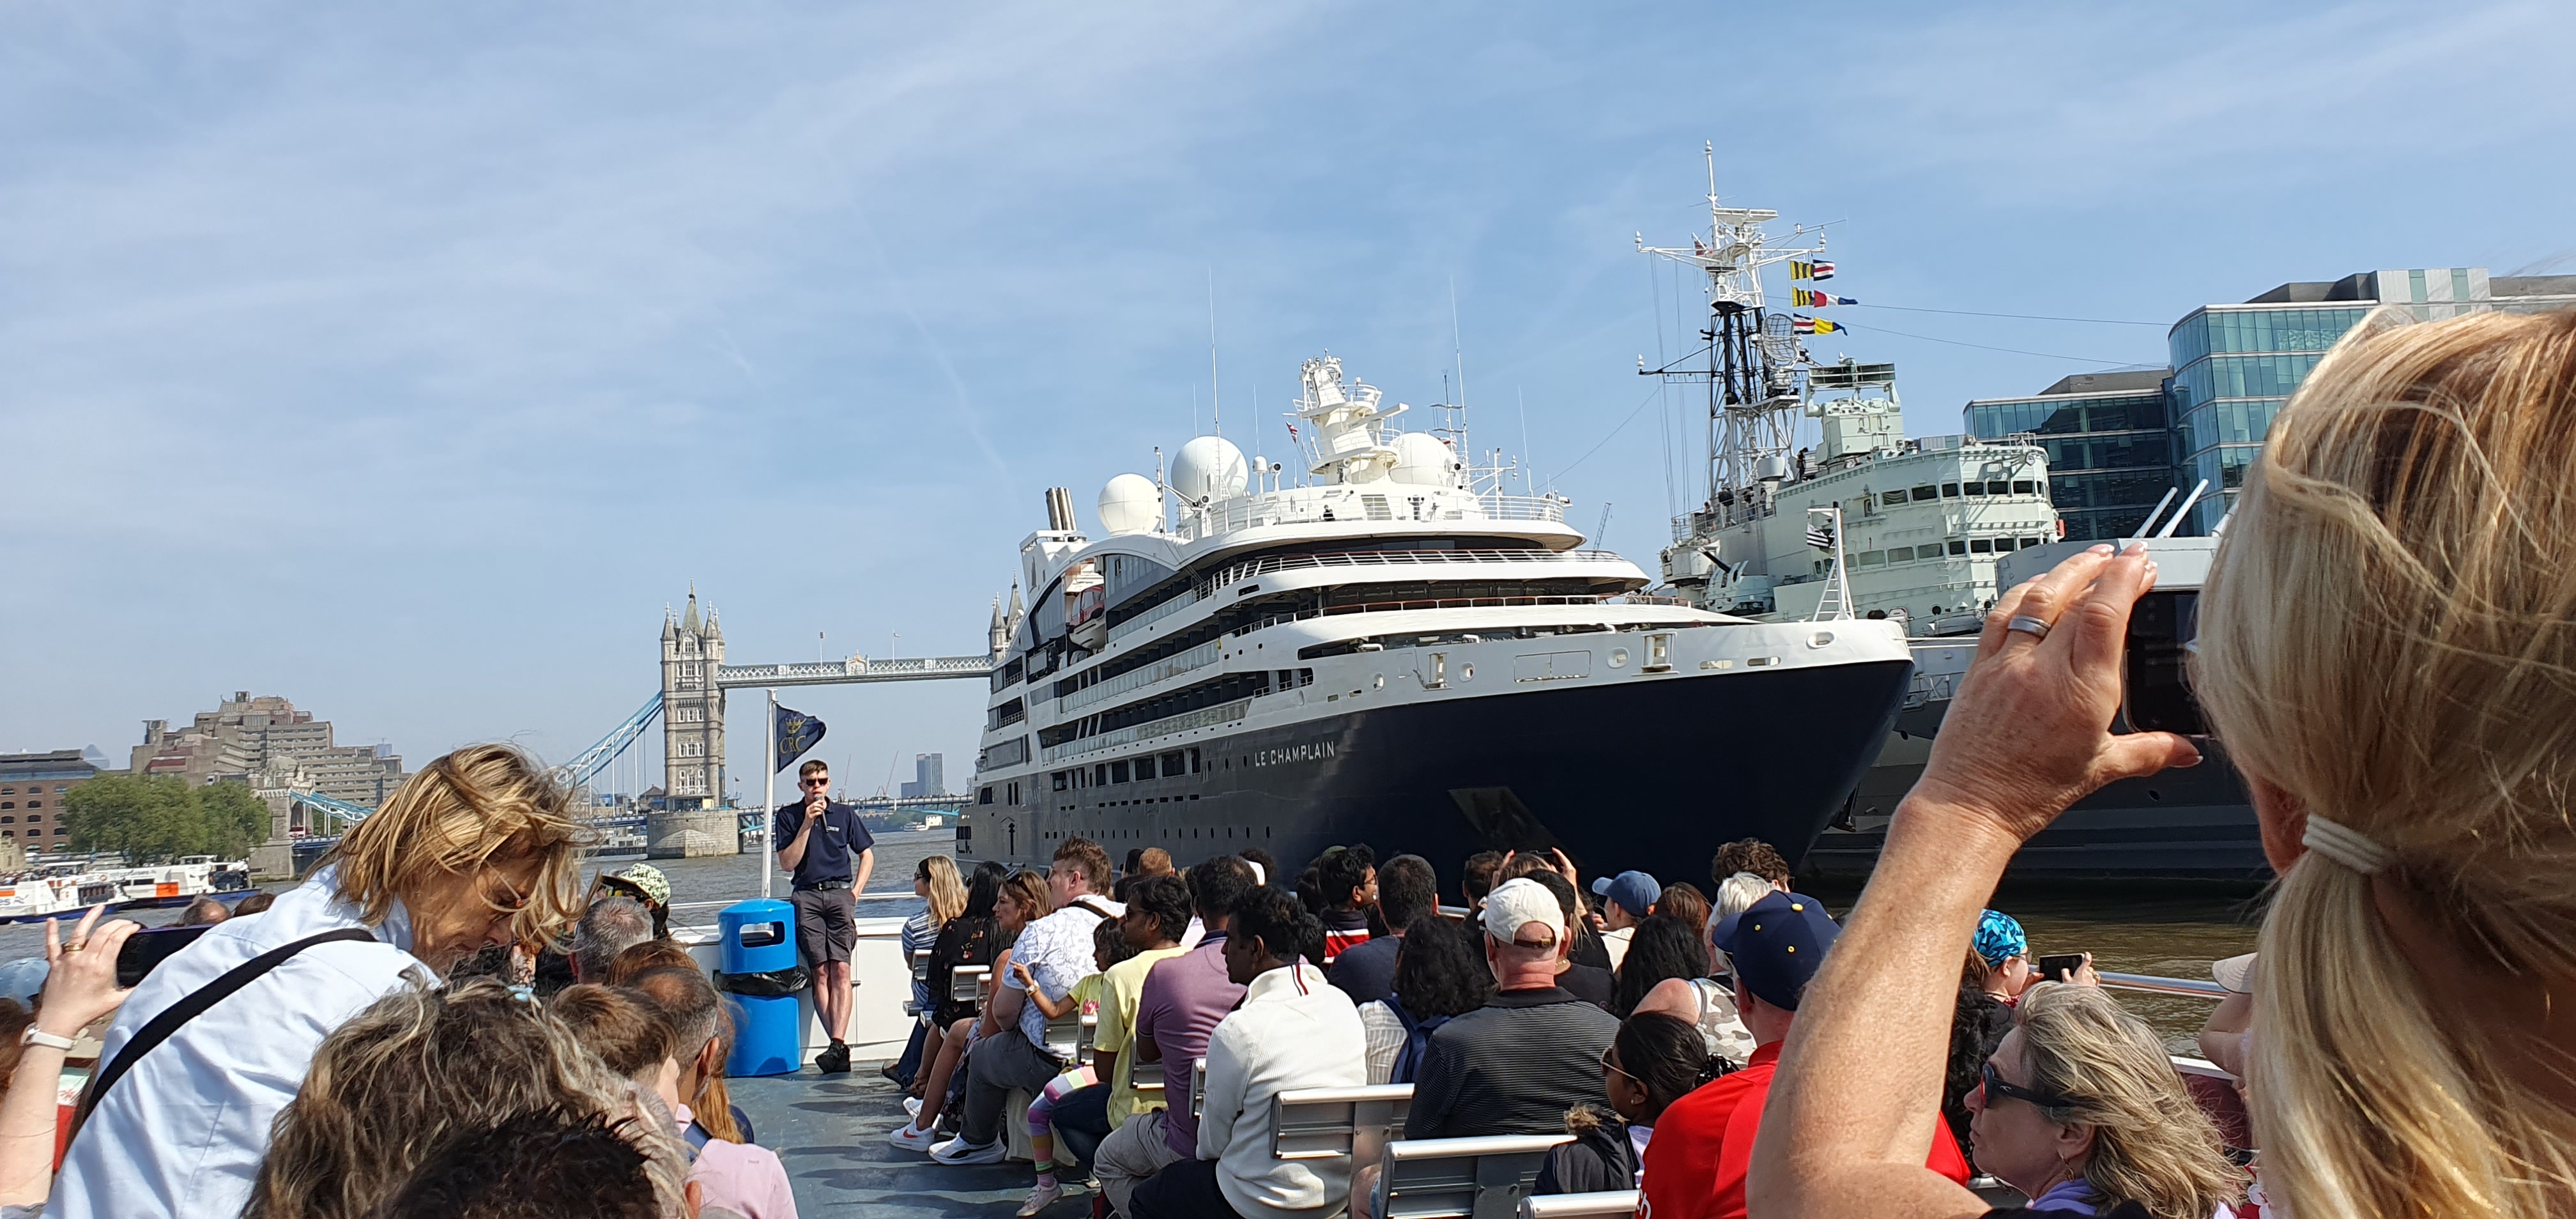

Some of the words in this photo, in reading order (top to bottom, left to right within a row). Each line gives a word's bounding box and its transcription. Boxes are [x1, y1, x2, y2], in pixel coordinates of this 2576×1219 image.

[779, 735, 806, 754] CRC
[1255, 751, 1266, 767] LE
[1270, 740, 1335, 765] CHAMPLAIN
